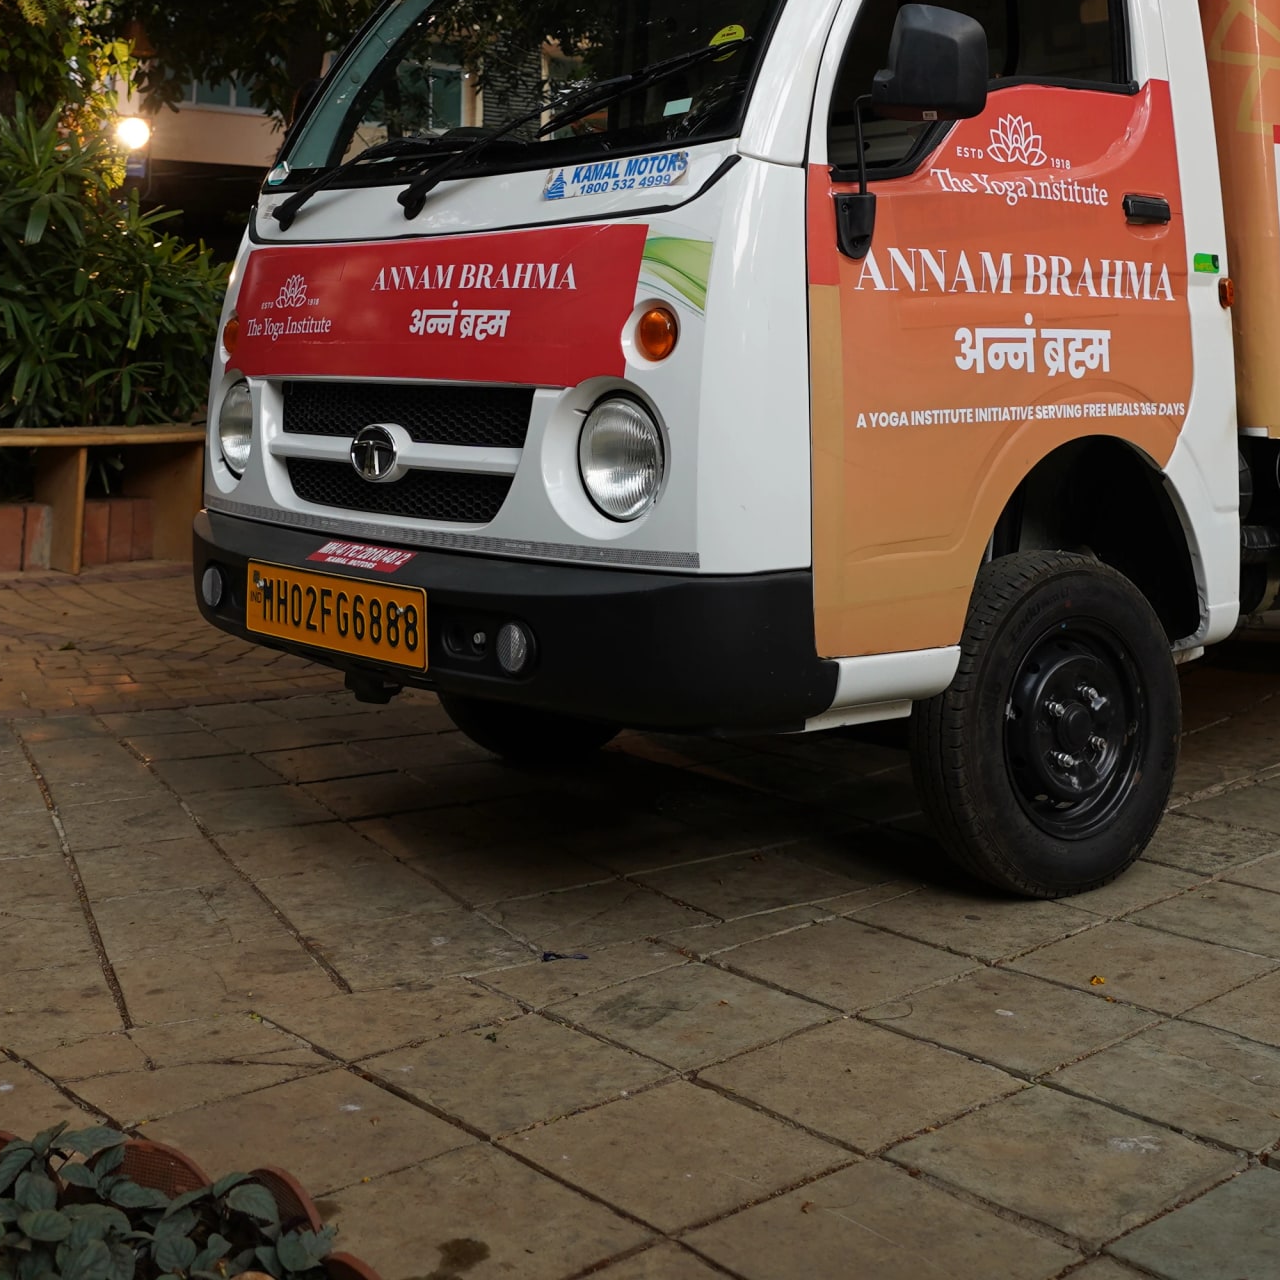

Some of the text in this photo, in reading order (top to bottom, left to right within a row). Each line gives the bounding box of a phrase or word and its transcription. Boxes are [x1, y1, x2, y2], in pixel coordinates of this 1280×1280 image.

[956, 146, 984, 160] ESTD
[1050, 157, 1071, 170] 1918
[571, 151, 689, 185] KAMAL MOTORS
[580, 174, 671, 195] 1800 532 4999
[930, 168, 1109, 206] The Yoga Institute
[371, 263, 577, 291] ANNAM BRAHMA
[854, 247, 1176, 302] ANNAM BRAHMA
[247, 315, 332, 341] The Yoga Institute
[409, 299, 511, 341] अन्नं ब्रह्म
[954, 312, 1112, 379] अन्नं ब्रह्म
[856, 402, 1185, 428] A YOGA INSTITUTE INITIATIVE SERVING FREE MEALS 365 DAYS
[250, 591, 262, 604] IND
[262, 577, 419, 652] MH02FG6888
